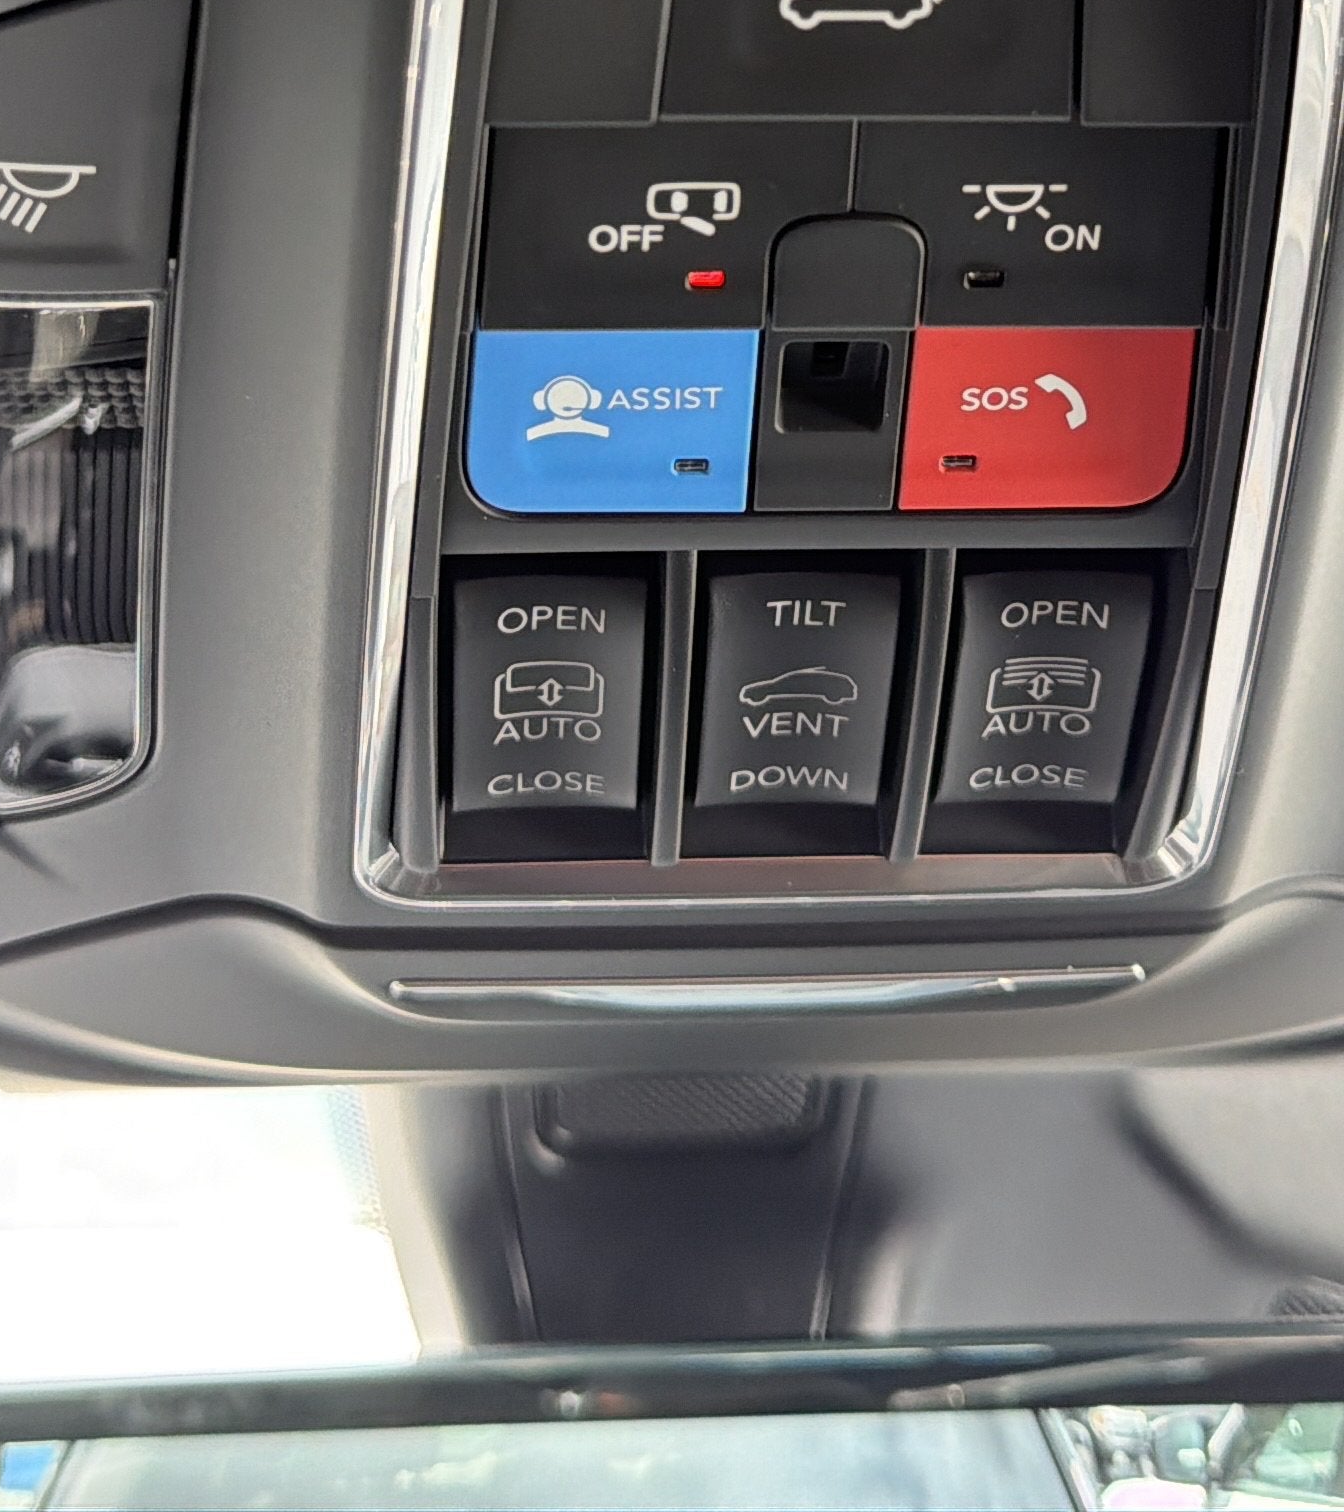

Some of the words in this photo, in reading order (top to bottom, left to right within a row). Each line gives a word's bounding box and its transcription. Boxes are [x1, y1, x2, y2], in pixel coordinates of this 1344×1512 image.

[588, 224, 665, 253] OFF
[1044, 224, 1102, 252] ON
[607, 386, 723, 411] ASSIST
[960, 386, 1029, 412] SOS
[497, 605, 606, 634] OPEN
[766, 599, 847, 627] TILT
[1000, 600, 1109, 630] OPEN
[493, 717, 602, 745] AUTO
[742, 711, 850, 738] VENT
[981, 710, 1091, 739] AUTO
[487, 770, 605, 797] CLOSE
[729, 765, 848, 793] DOWN
[969, 763, 1086, 791] CLOSE
